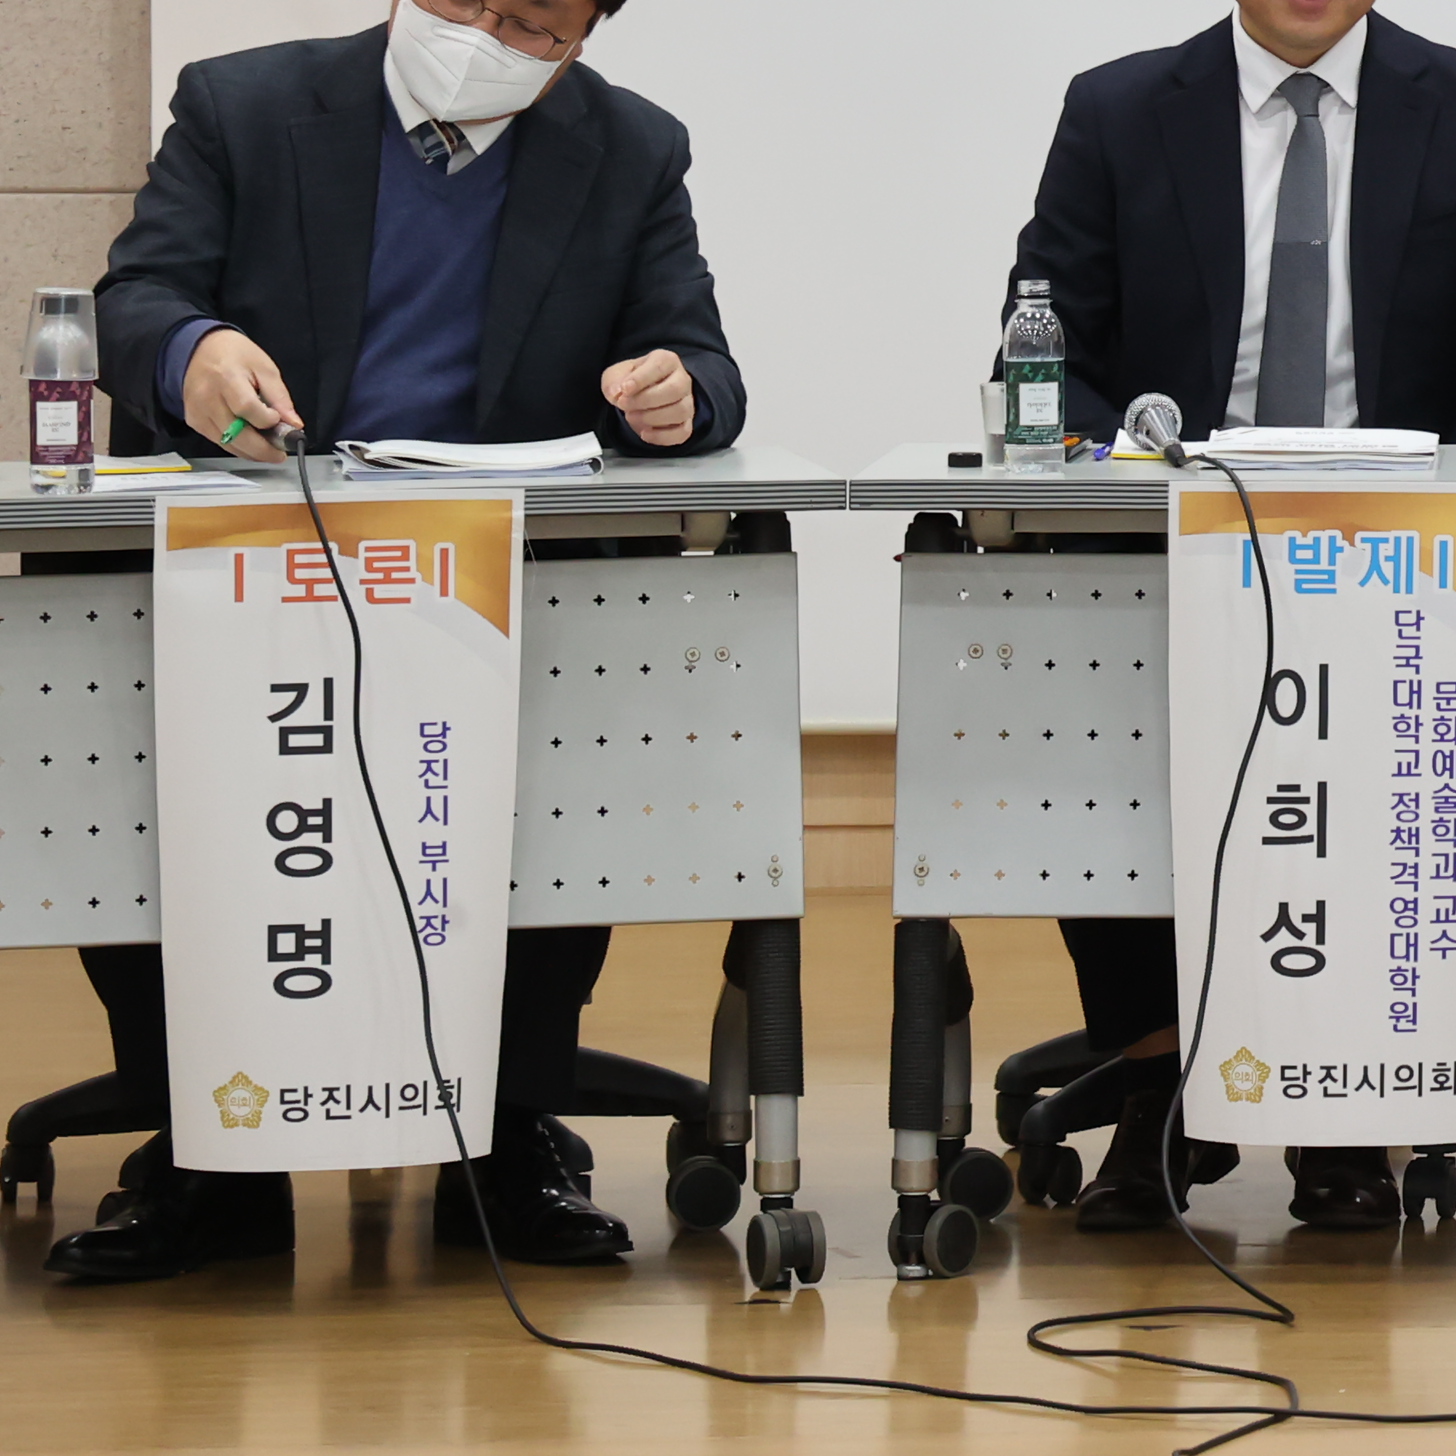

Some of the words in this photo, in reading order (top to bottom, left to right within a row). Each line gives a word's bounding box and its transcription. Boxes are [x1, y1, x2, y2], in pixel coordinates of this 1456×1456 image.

[280, 544, 418, 604] 토론
[1288, 534, 1416, 595] 발제
[1391, 609, 1425, 778] 단국대학교
[418, 720, 452, 826] 당진시
[417, 841, 450, 946] 부시장
[1388, 792, 1422, 1033] 정책격영대학원
[279, 1077, 462, 1123] 당진시의회
